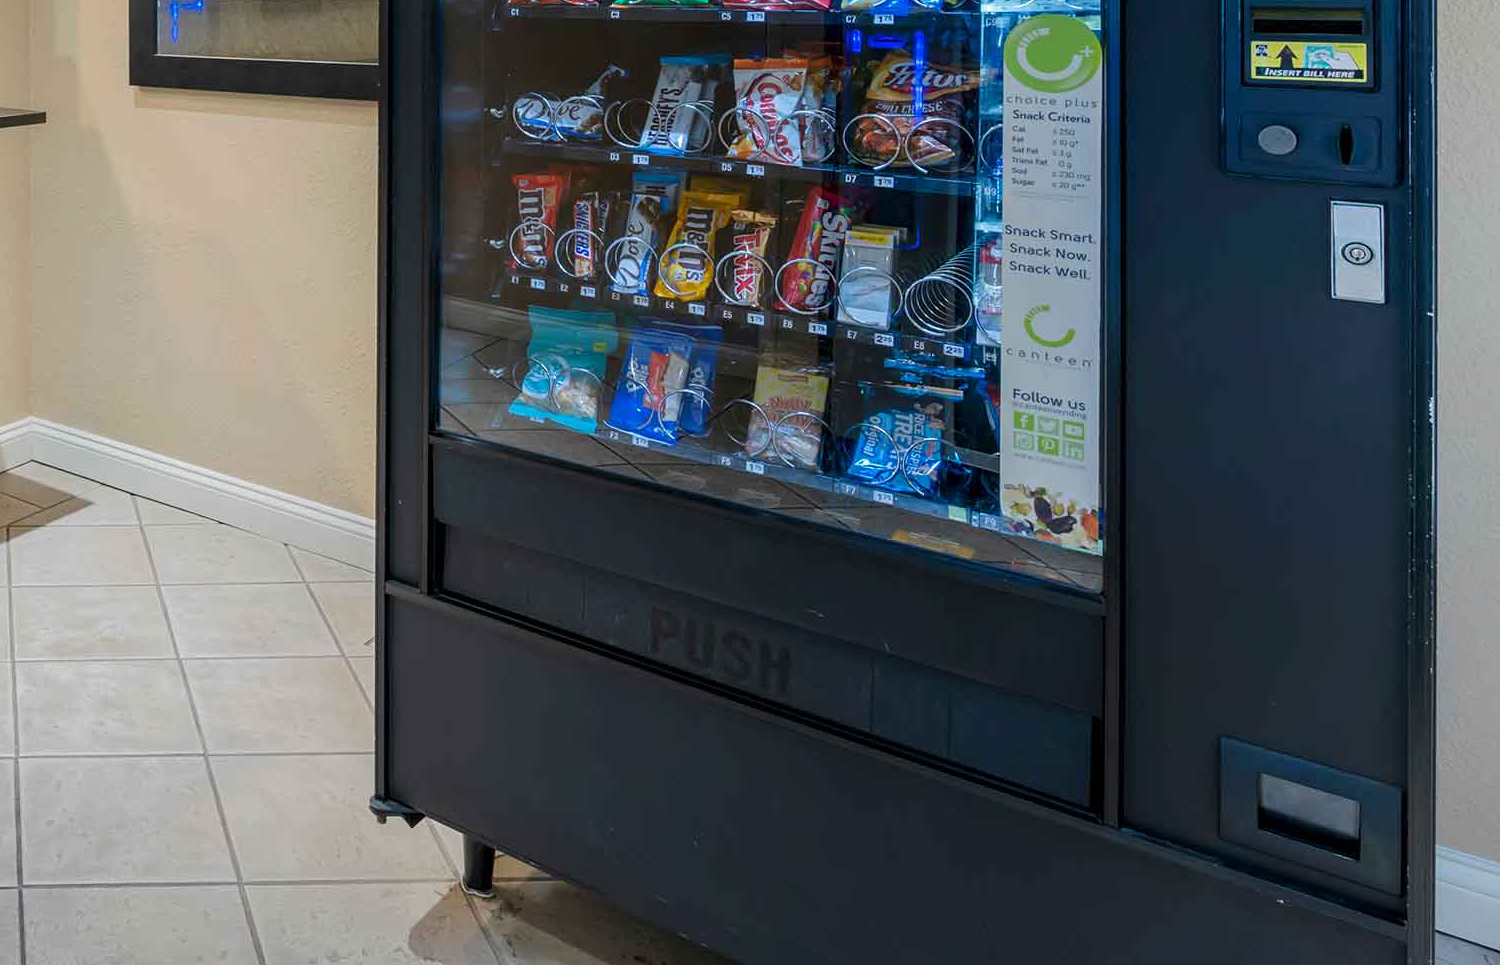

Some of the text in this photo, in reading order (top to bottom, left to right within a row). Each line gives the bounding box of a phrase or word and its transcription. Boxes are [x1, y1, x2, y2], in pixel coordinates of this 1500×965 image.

[510, 8, 519, 17] C1
[610, 10, 620, 20] C3
[721, 12, 732, 21] C5
[845, 15, 857, 24] C7
[1265, 67, 1356, 79] INSERT BILL HERE
[1006, 96, 1099, 109] choice plus
[1012, 109, 1091, 124] Snack Criteria
[845, 174, 857, 184] D7
[1004, 224, 1097, 244] Snack Smart.
[1009, 242, 1092, 262] Snack Now.
[1008, 260, 1091, 281] Snack Well.
[665, 300, 675, 310] E4
[723, 310, 733, 319] E5
[783, 319, 793, 329] E6
[847, 330, 858, 340] E7
[914, 340, 925, 350] E8
[1005, 347, 1092, 368] canteen
[1012, 388, 1087, 412] Follow us
[648, 604, 793, 696] PUSH
